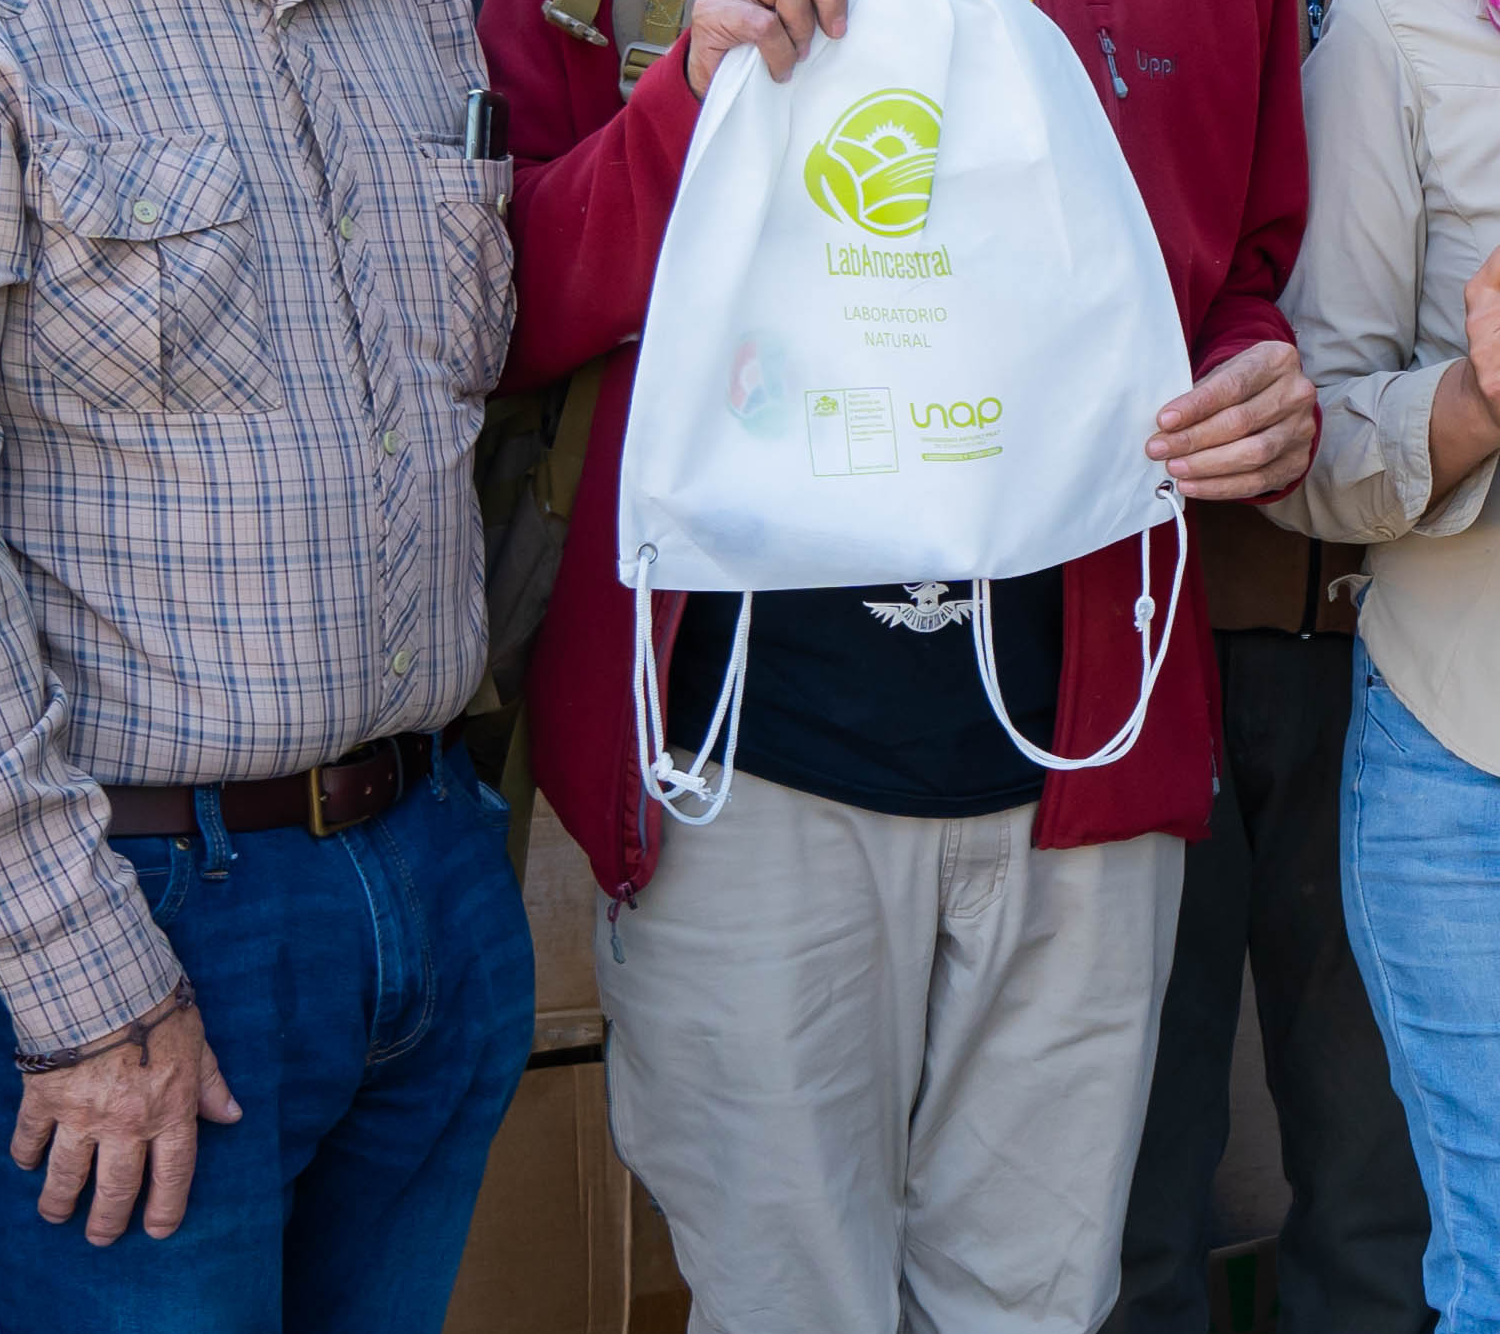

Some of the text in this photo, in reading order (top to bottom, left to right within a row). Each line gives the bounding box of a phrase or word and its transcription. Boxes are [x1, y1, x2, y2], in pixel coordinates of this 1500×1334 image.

[826, 242, 953, 279] LabAncestral
[844, 306, 948, 323] LABORATORIO
[864, 331, 932, 348] NATURAL
